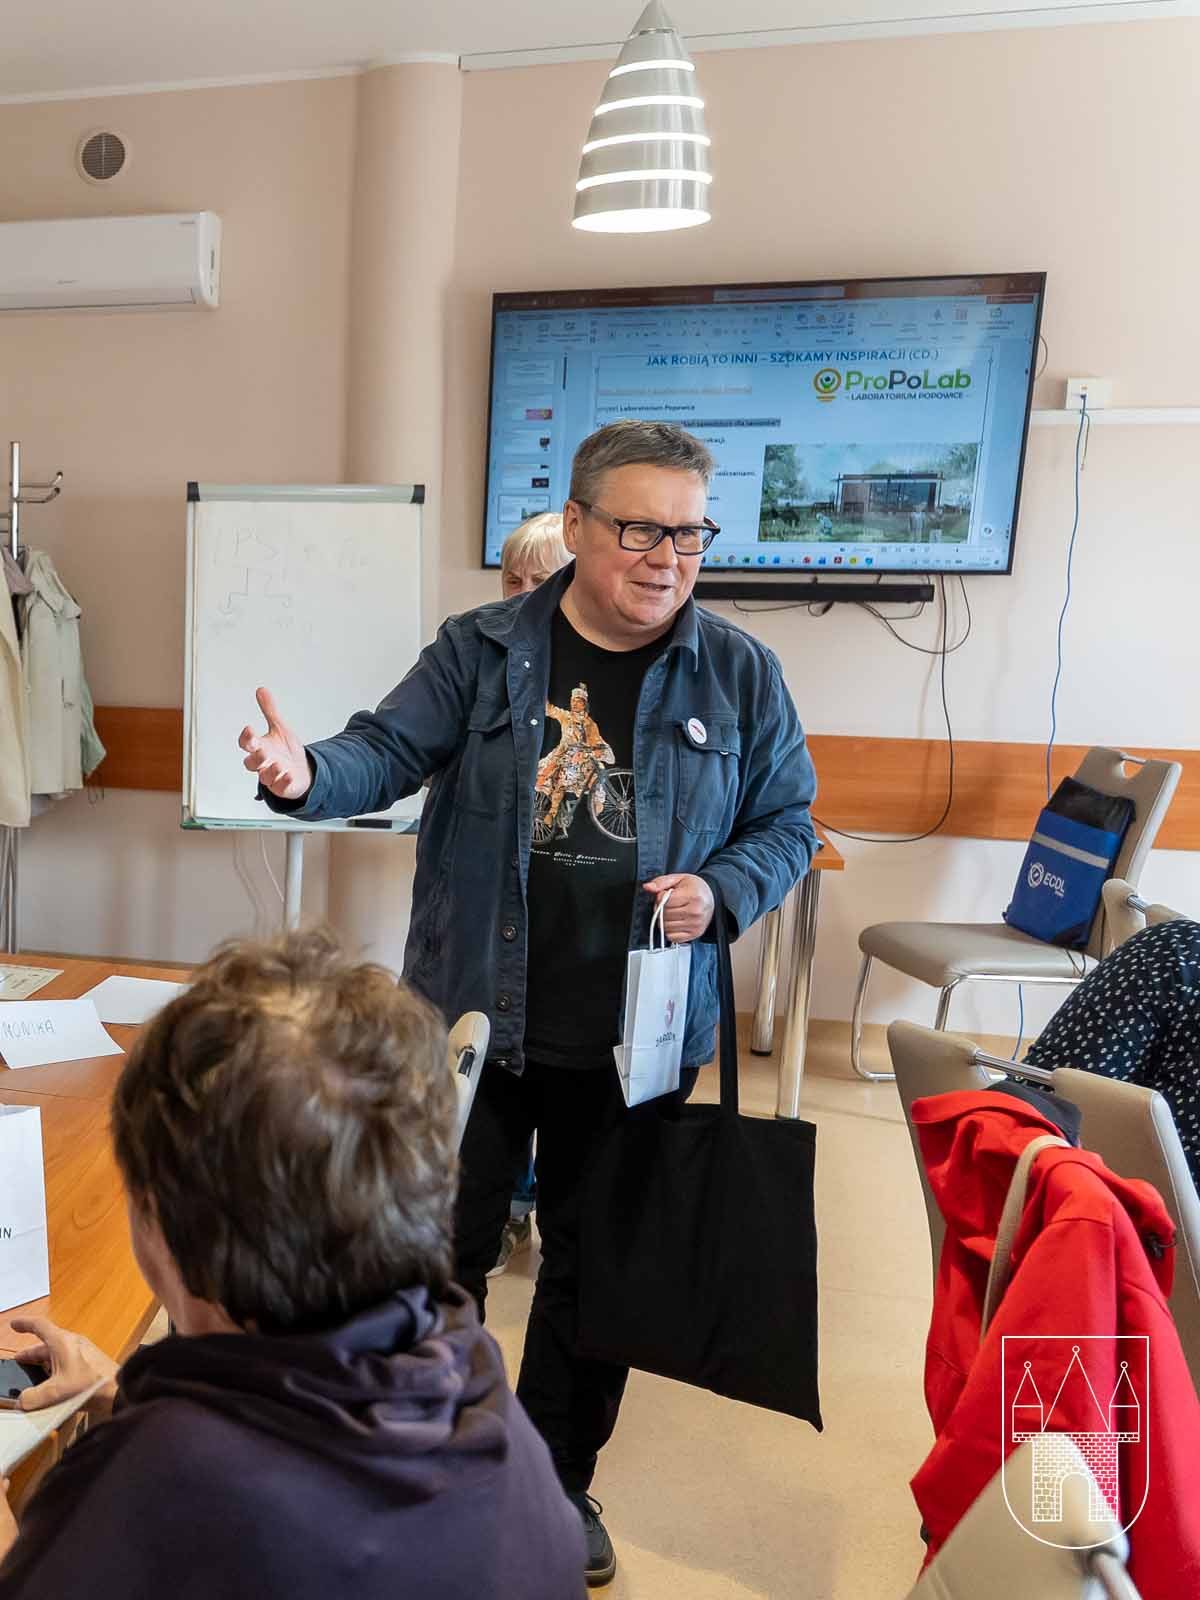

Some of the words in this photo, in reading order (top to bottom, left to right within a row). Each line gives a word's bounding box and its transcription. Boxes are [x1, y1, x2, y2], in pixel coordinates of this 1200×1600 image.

[647, 355, 667, 367] JAK
[671, 354, 709, 367] ROBIĄ
[712, 353, 729, 364] TO
[731, 352, 758, 364] INNI
[770, 351, 833, 363] SZUKAMY
[836, 349, 906, 362] INSPIRACJI
[844, 368, 972, 391] ProPoLab
[1043, 871, 1065, 893] ECDL
[1, 1018, 55, 1039] MONIKA
